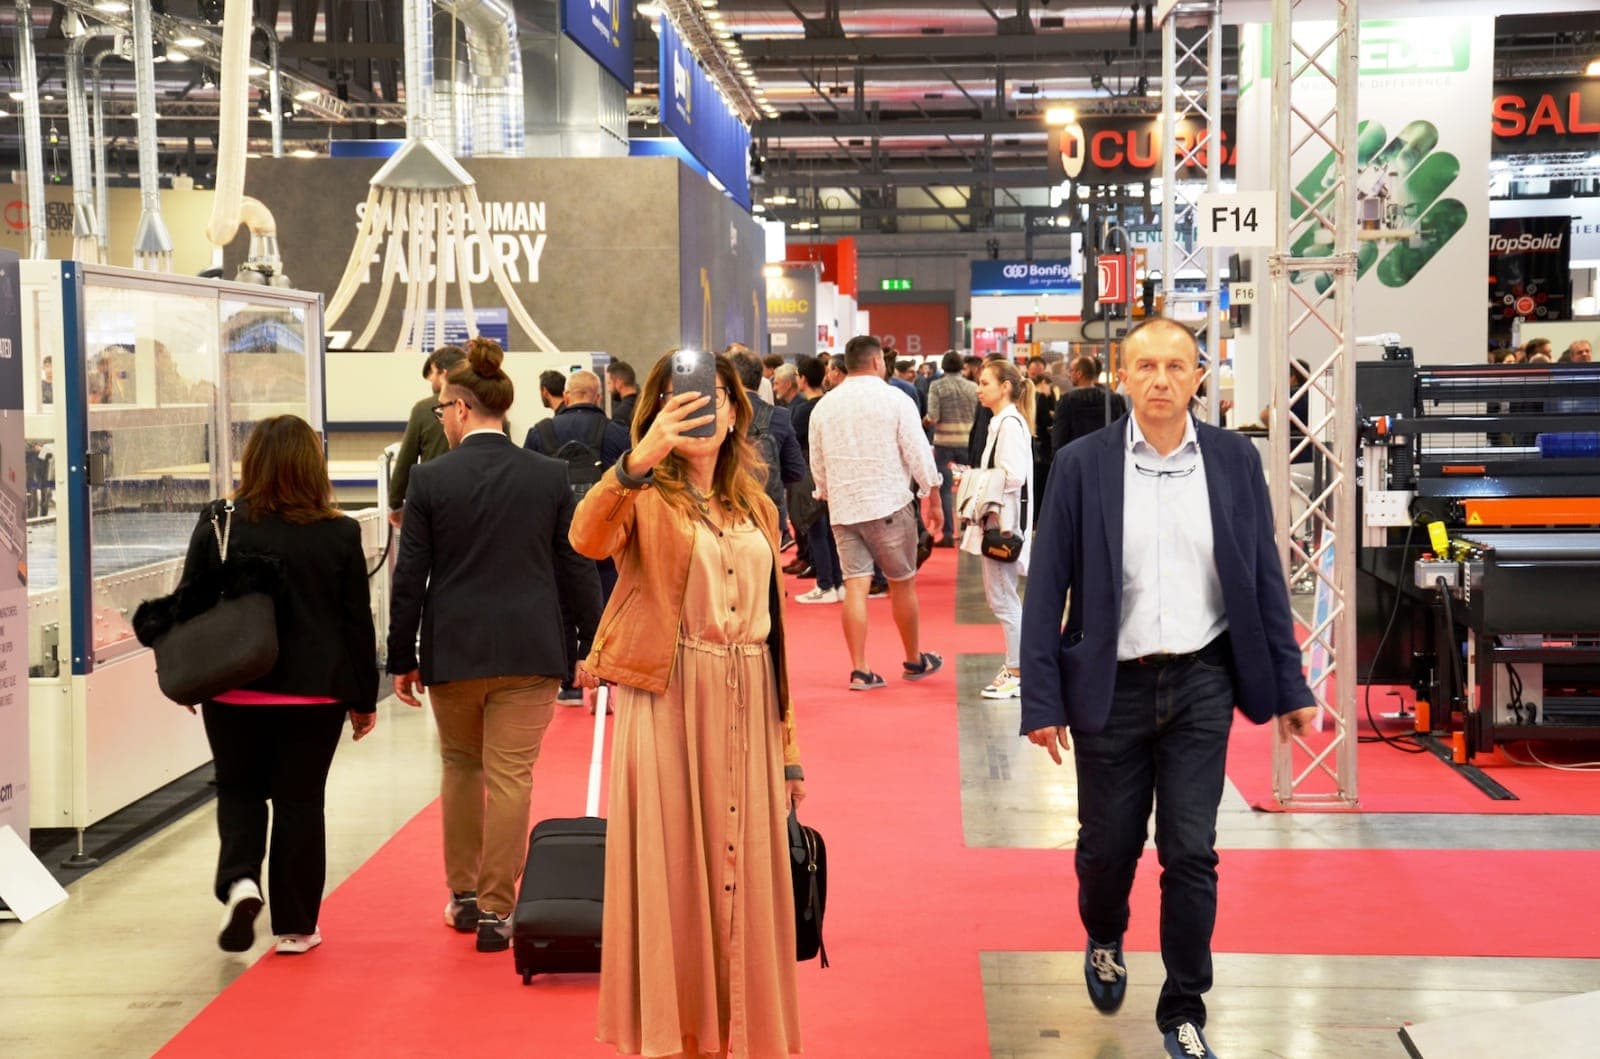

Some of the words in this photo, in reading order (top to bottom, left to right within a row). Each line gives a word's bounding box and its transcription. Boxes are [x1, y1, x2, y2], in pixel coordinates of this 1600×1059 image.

[1212, 207, 1258, 232] F14
[1489, 233, 1562, 254] TopSolid
[357, 234, 547, 283] FACTORY
[1235, 288, 1254, 299] F16
